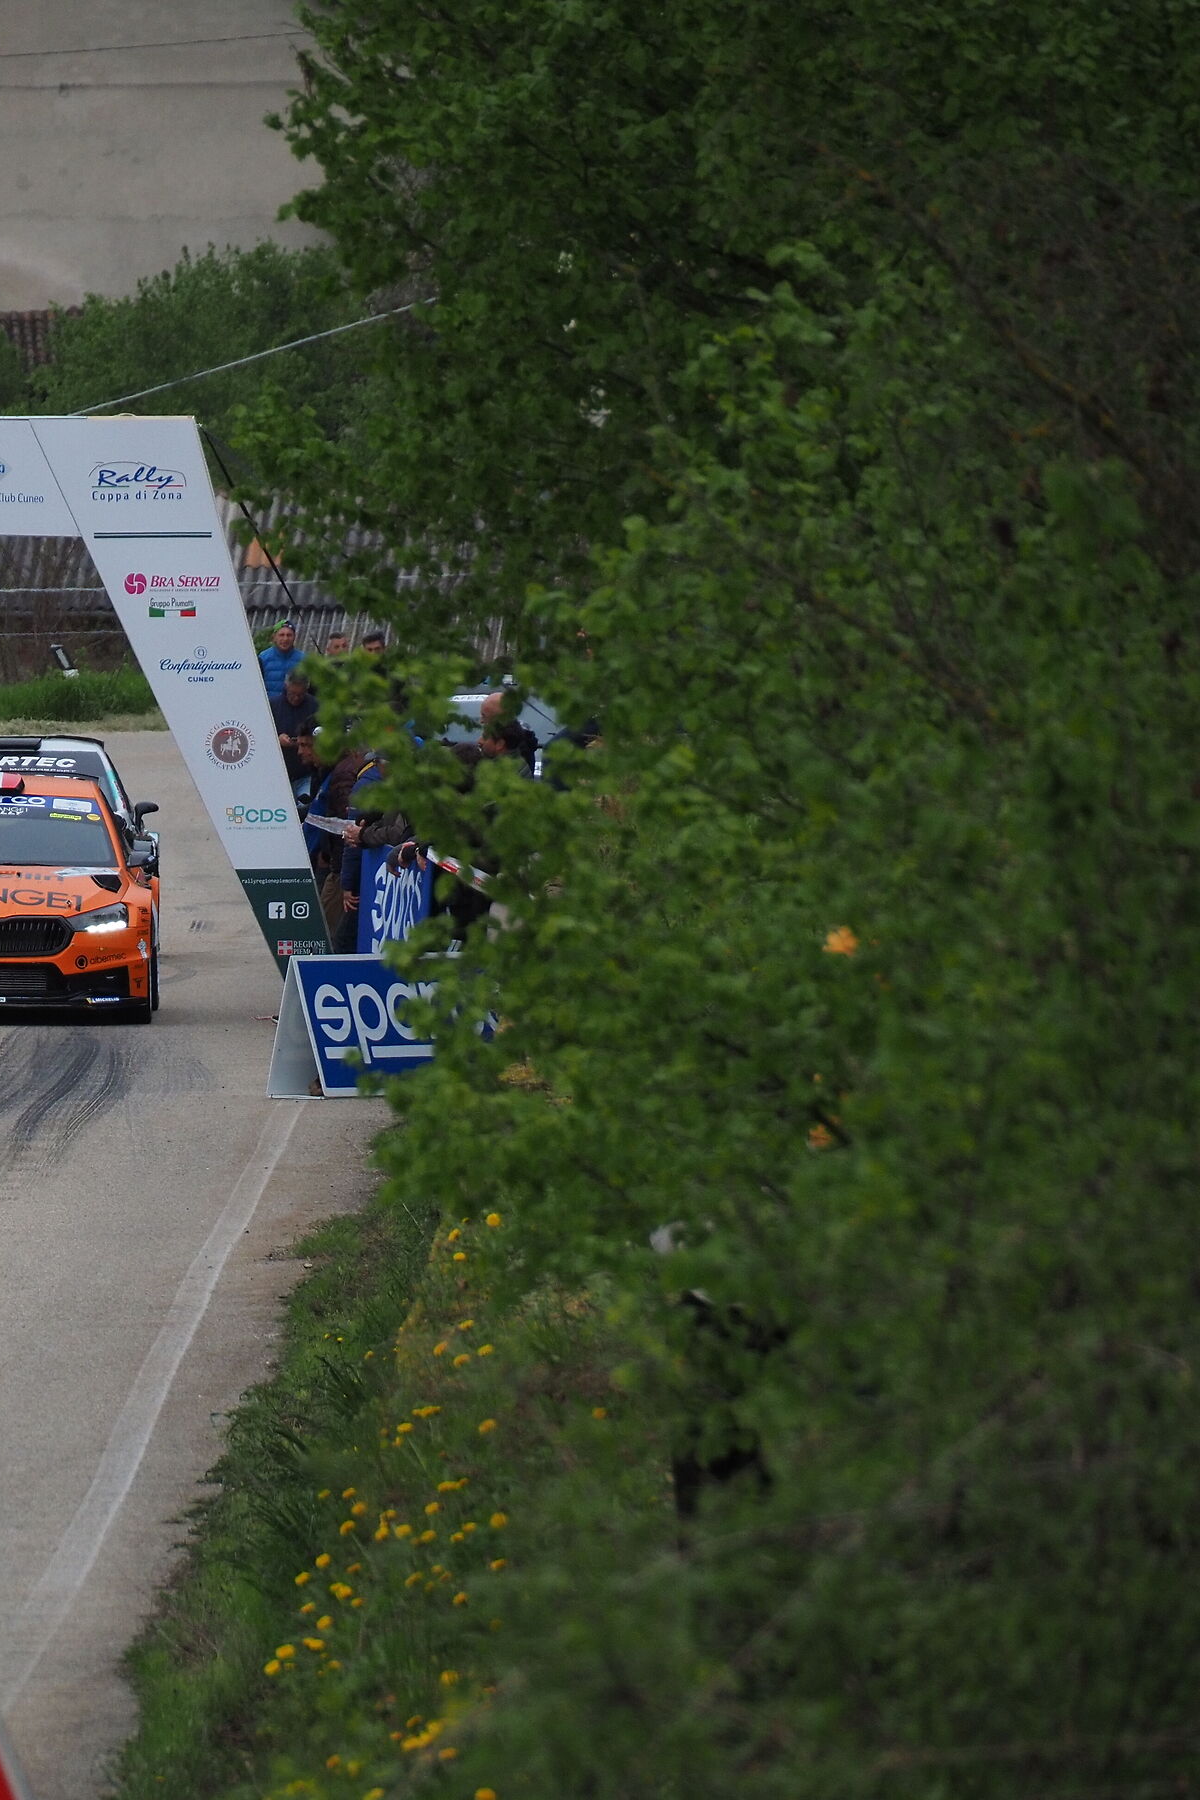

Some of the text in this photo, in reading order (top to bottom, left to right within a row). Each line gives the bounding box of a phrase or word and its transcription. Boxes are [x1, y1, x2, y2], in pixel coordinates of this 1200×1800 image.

[98, 466, 174, 489] Rally
[17, 493, 45, 503] Cuneo
[92, 489, 182, 502] Coppa di Zona
[150, 574, 221, 587] BRA SERVIZI
[150, 597, 171, 608] Gruppo
[159, 658, 242, 675] Confartigianato
[245, 808, 288, 823] CDS
[293, 940, 326, 948] REGIONE
